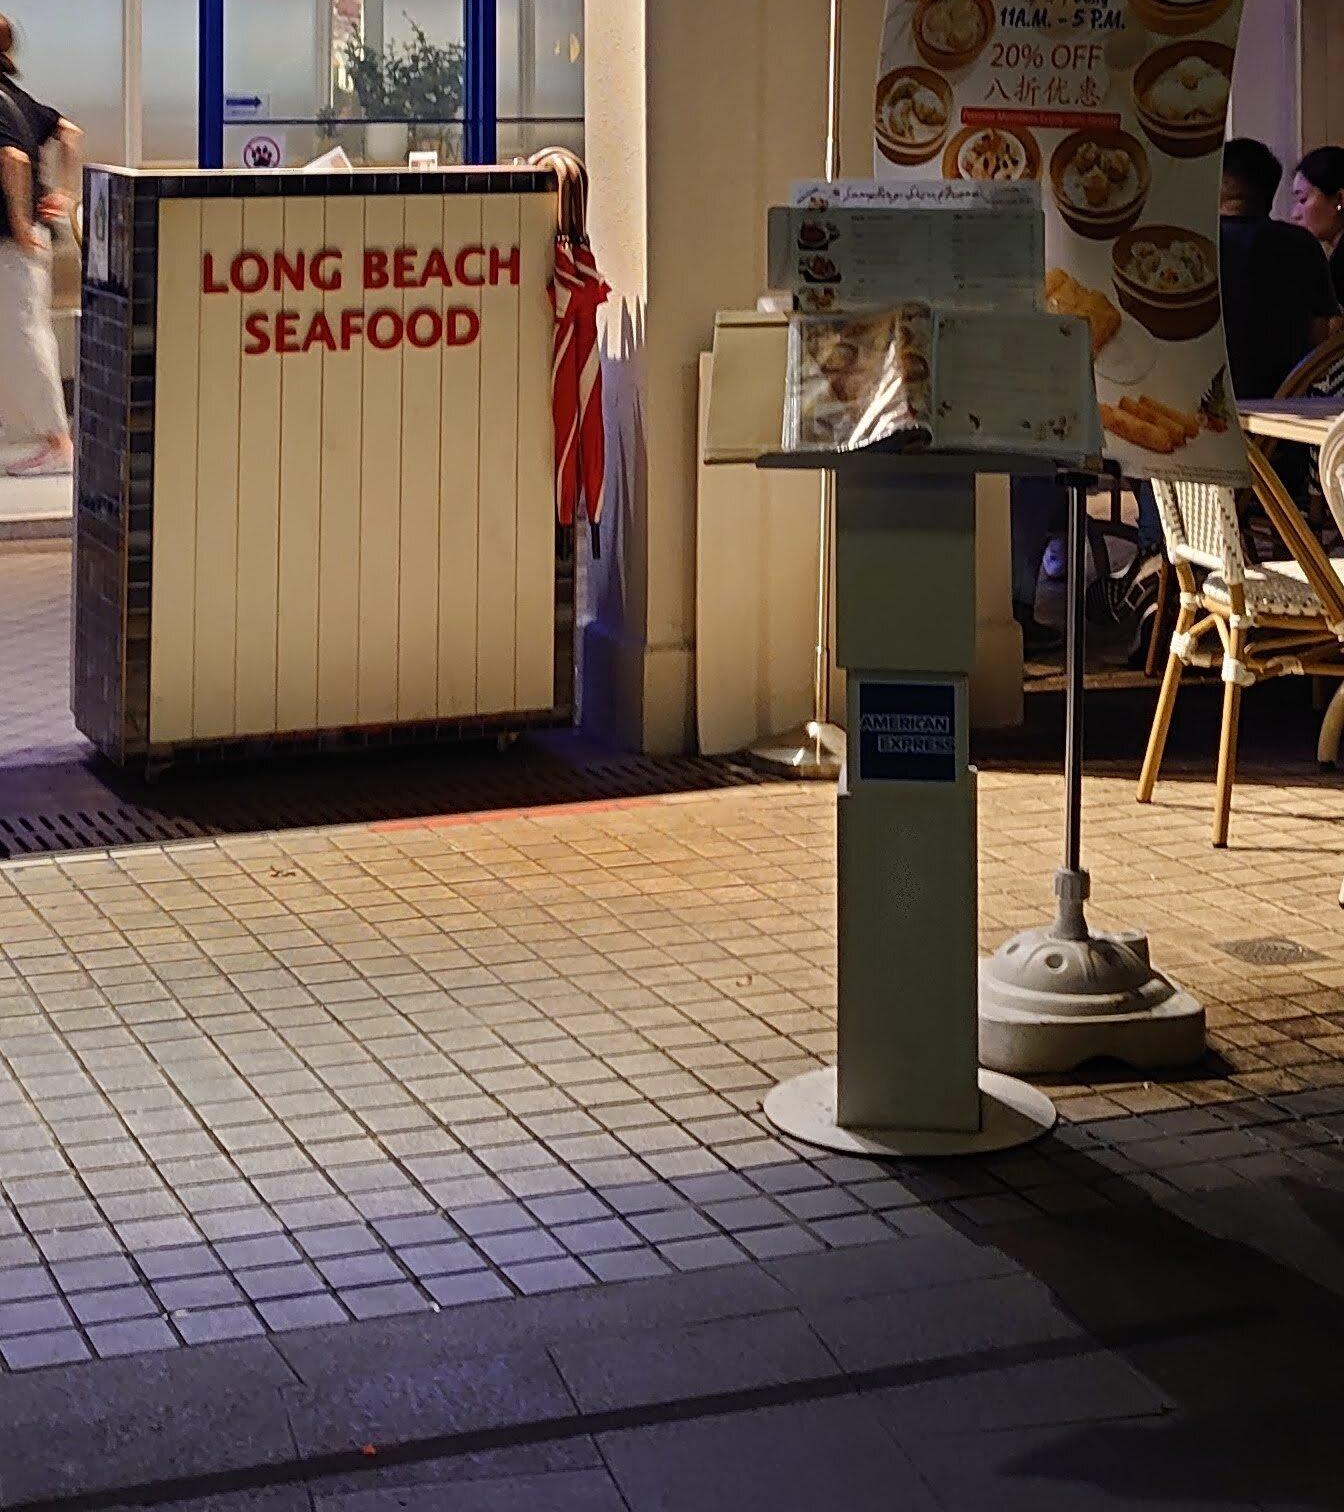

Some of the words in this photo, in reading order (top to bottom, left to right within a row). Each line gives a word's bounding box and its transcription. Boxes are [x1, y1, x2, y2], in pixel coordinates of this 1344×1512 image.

[1072, 8, 1085, 27] 5
[1090, 8, 1125, 29] P.M.
[990, 43, 1044, 68] 20%
[1051, 44, 1103, 70] OFF
[984, 75, 1101, 107] 八折优惠
[200, 249, 343, 295] LONG
[362, 245, 521, 289] BEACH
[243, 305, 481, 356] SEAFOOD
[860, 713, 950, 734] AMERICAN
